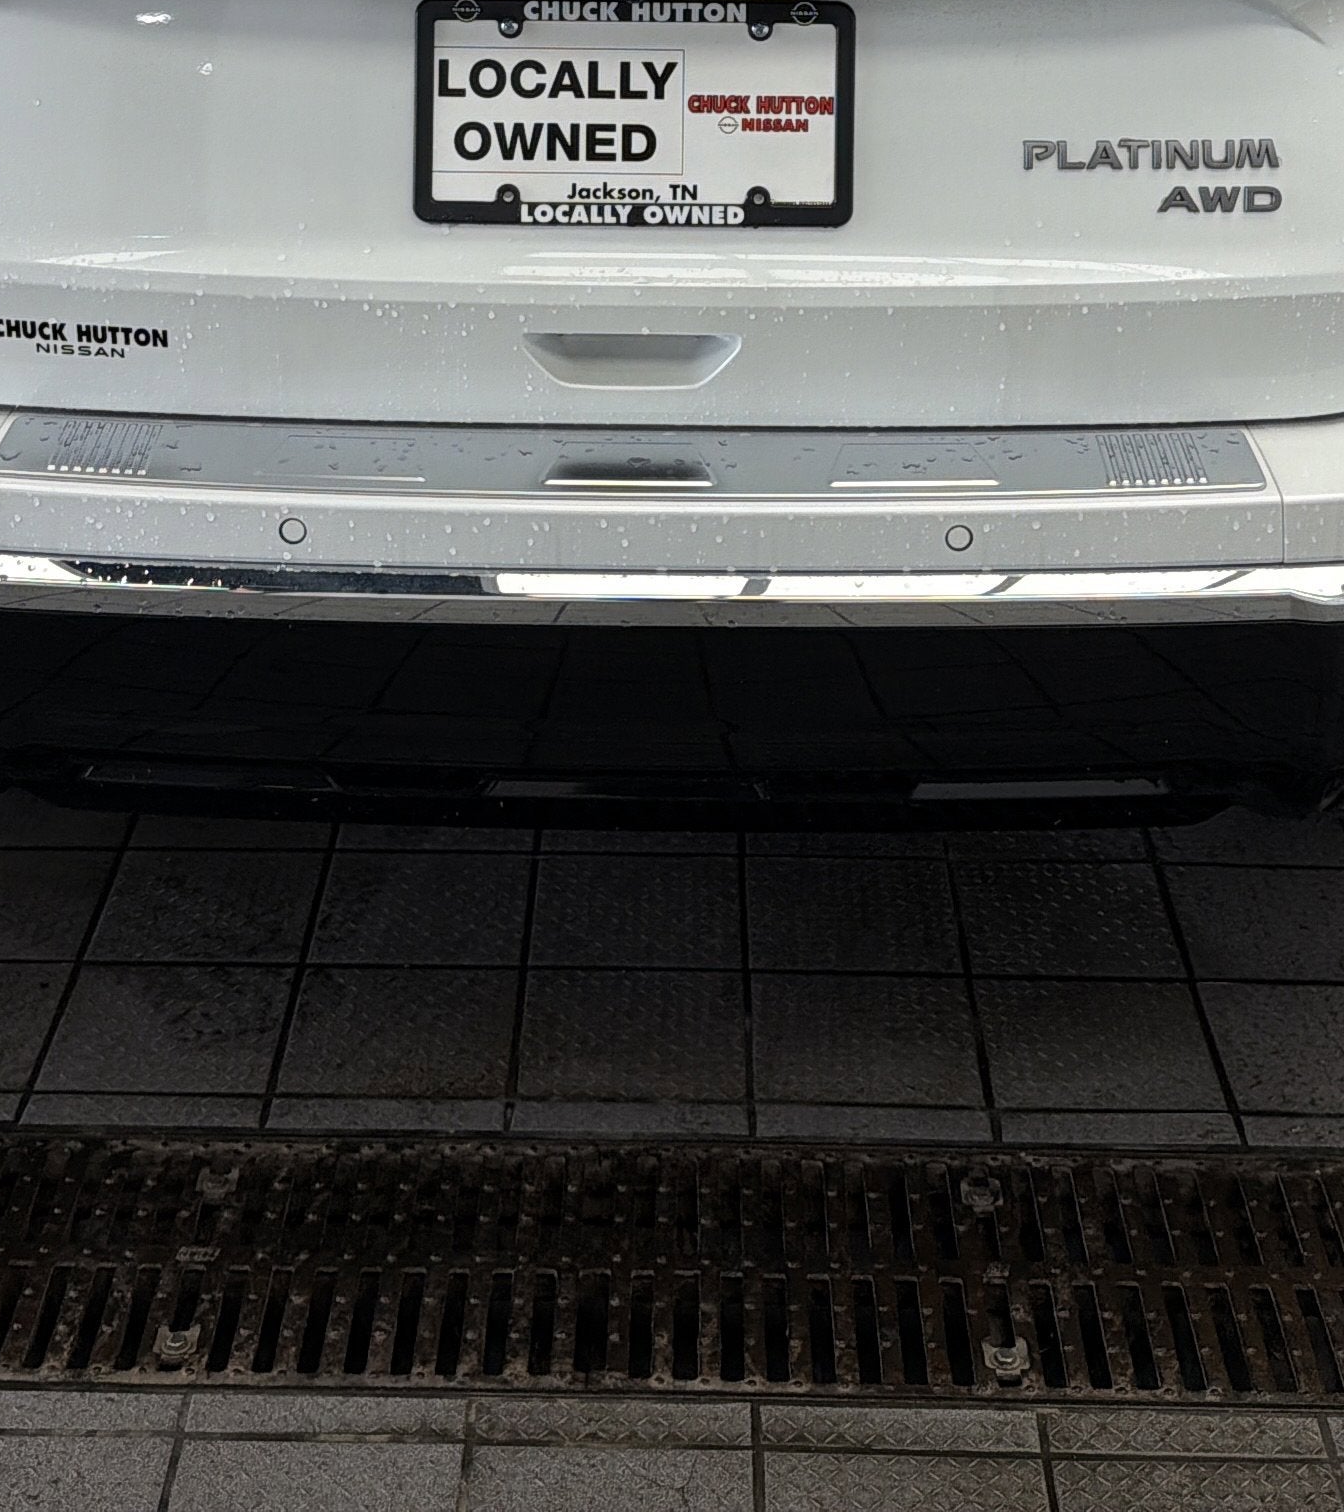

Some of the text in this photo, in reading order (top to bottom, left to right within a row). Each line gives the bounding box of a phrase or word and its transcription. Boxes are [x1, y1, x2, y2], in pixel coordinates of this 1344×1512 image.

[523, 0, 748, 23] CHUCK HUTTON
[438, 58, 678, 100] LOCALLY
[687, 94, 835, 115] CHUCK HUTTON
[742, 118, 809, 132] NISSAN
[454, 121, 657, 163] OWNED
[1022, 138, 1281, 171] PLATINUM
[567, 182, 698, 203] Jackson, TN
[1156, 186, 1283, 213] AWD
[520, 204, 746, 226] LOCALLY OWNED
[76, 323, 169, 348] HUTTON
[36, 343, 126, 359] NISSAN
